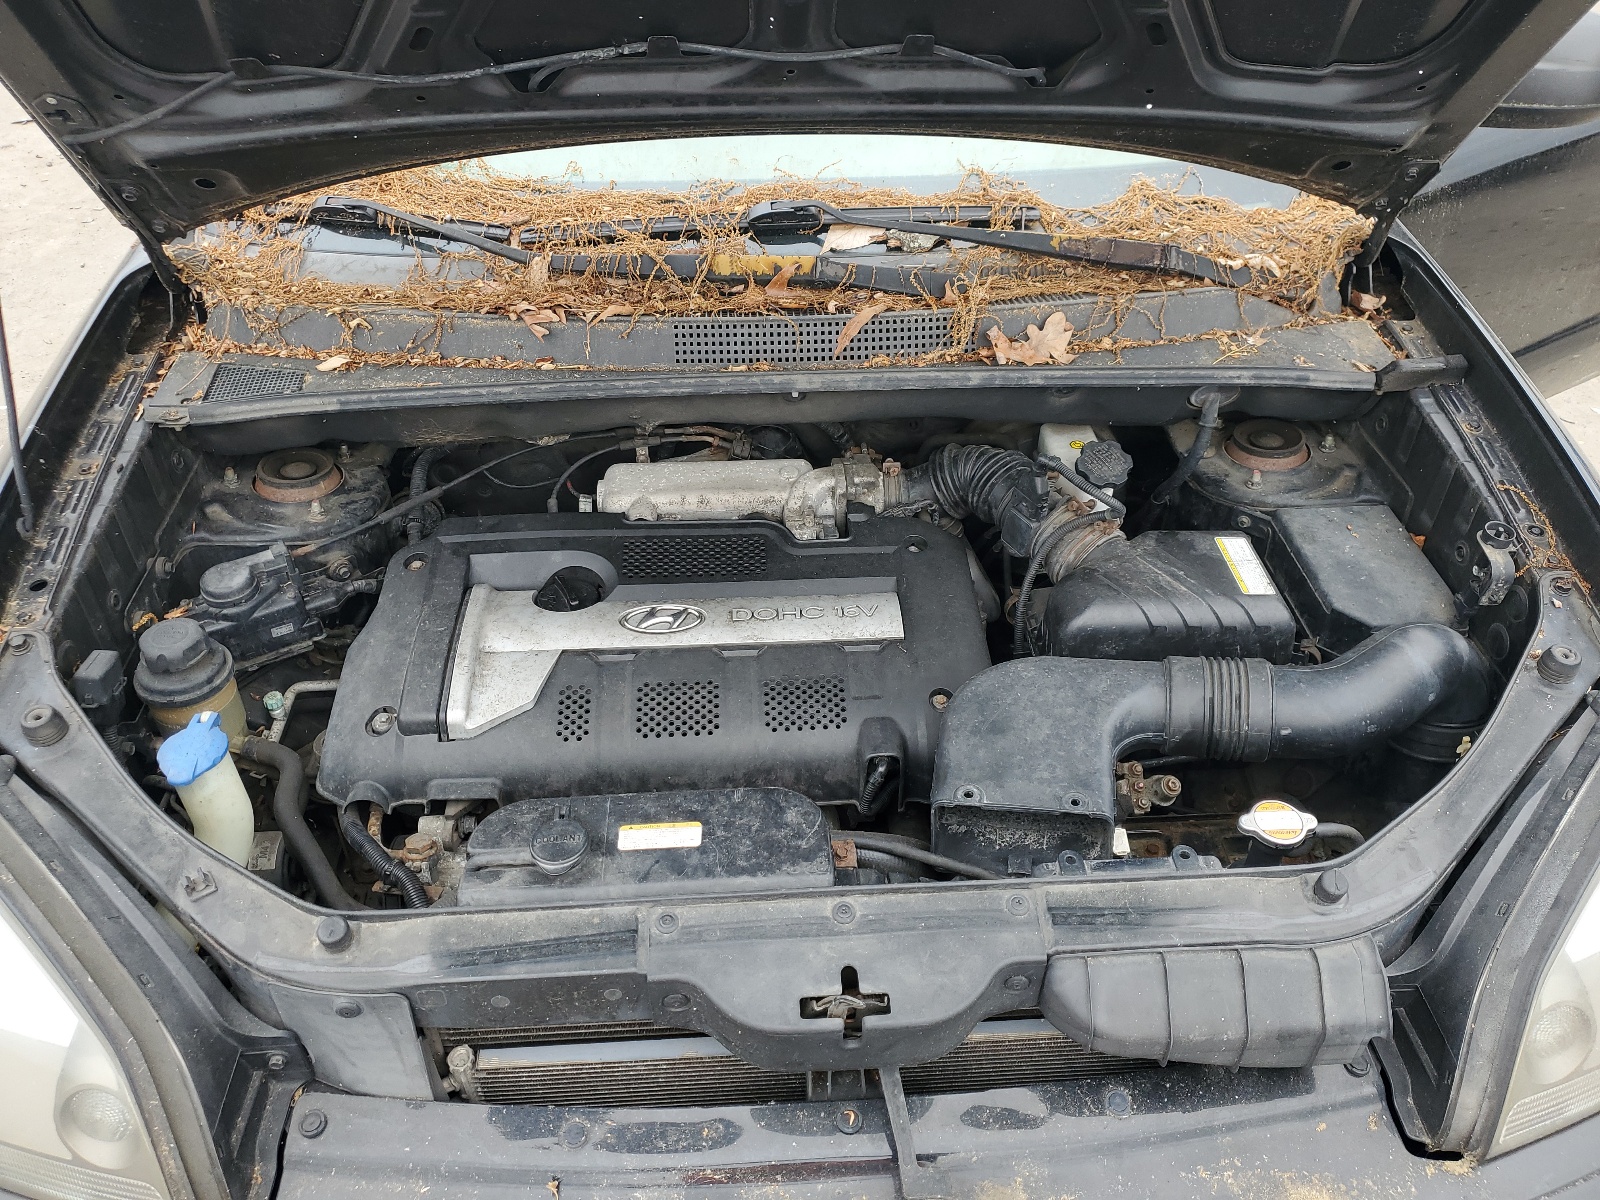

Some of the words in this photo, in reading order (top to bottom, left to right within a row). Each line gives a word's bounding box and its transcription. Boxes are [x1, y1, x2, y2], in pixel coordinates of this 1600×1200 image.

[730, 605, 825, 622] DOHC
[834, 603, 879, 618] 16V
[534, 833, 583, 845] COOLANT
